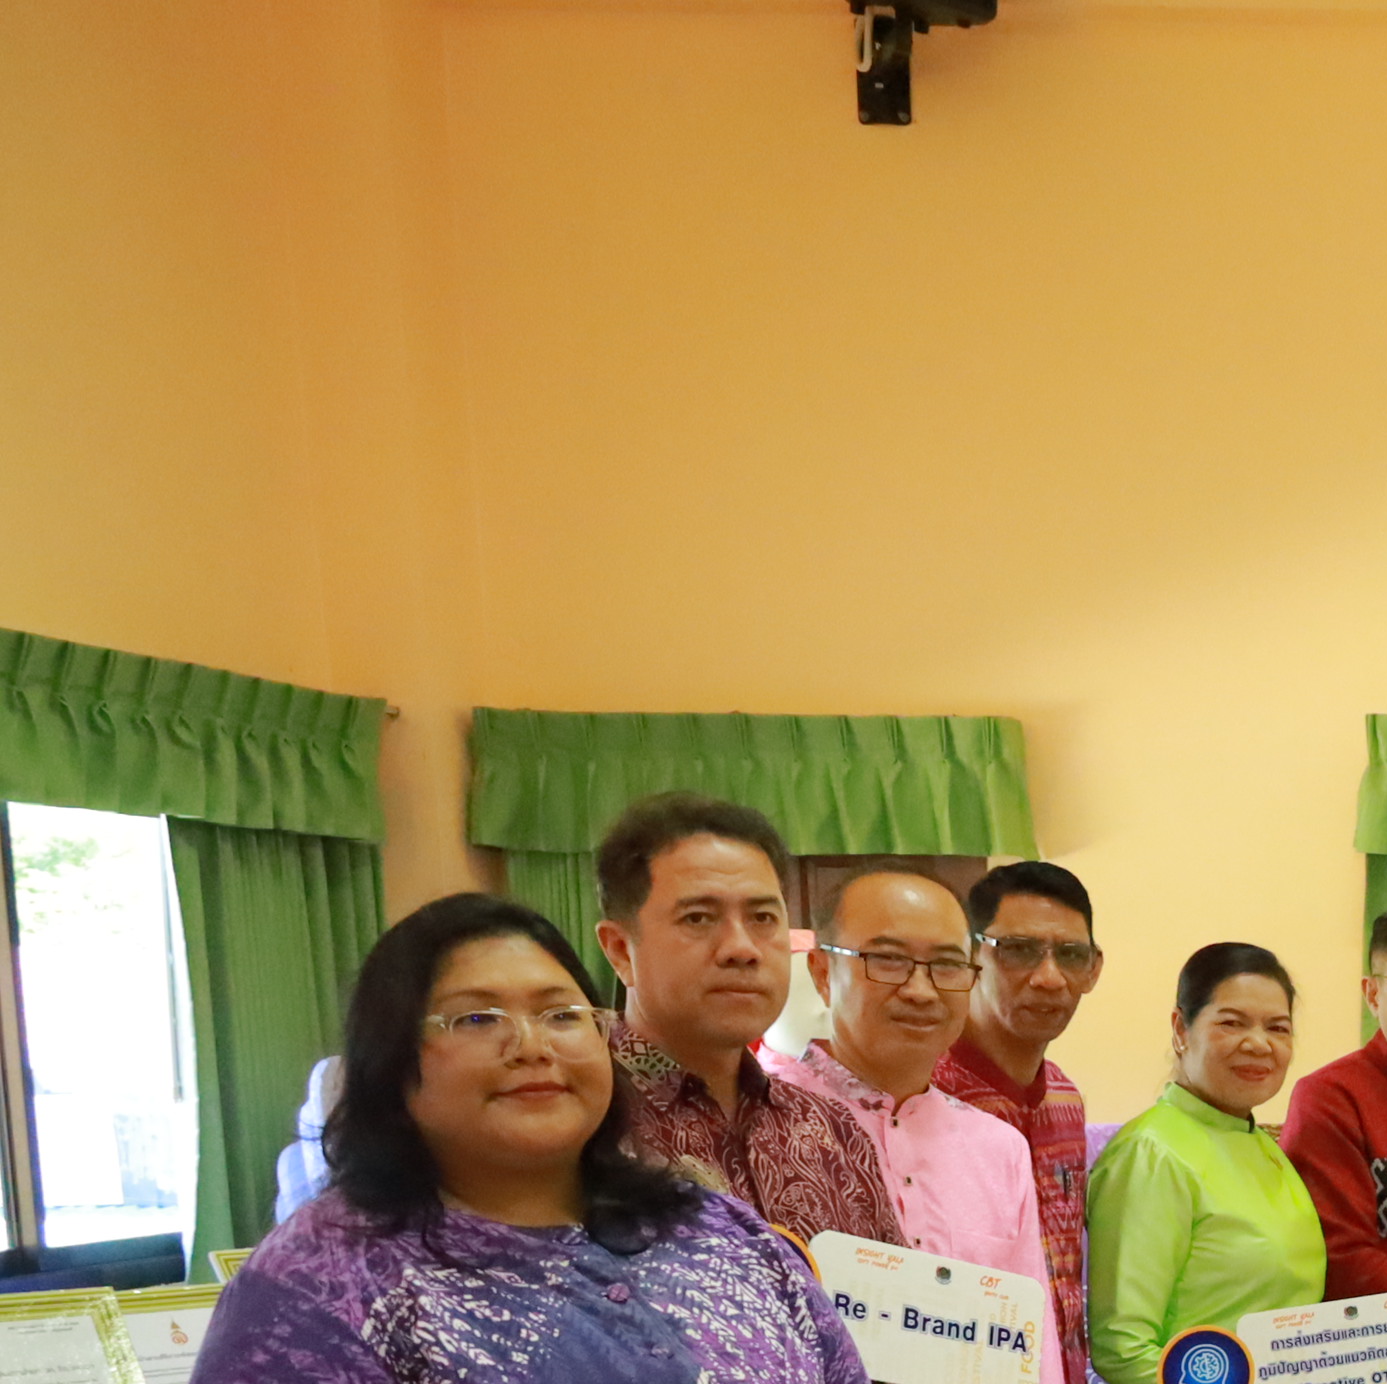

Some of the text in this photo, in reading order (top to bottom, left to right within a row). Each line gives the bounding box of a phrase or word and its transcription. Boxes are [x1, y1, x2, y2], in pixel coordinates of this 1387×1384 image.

[980, 1275, 1002, 1289] CBT
[835, 1293, 867, 1319] Re
[903, 1308, 976, 1342] Brand
[988, 1325, 1028, 1353] IPA
